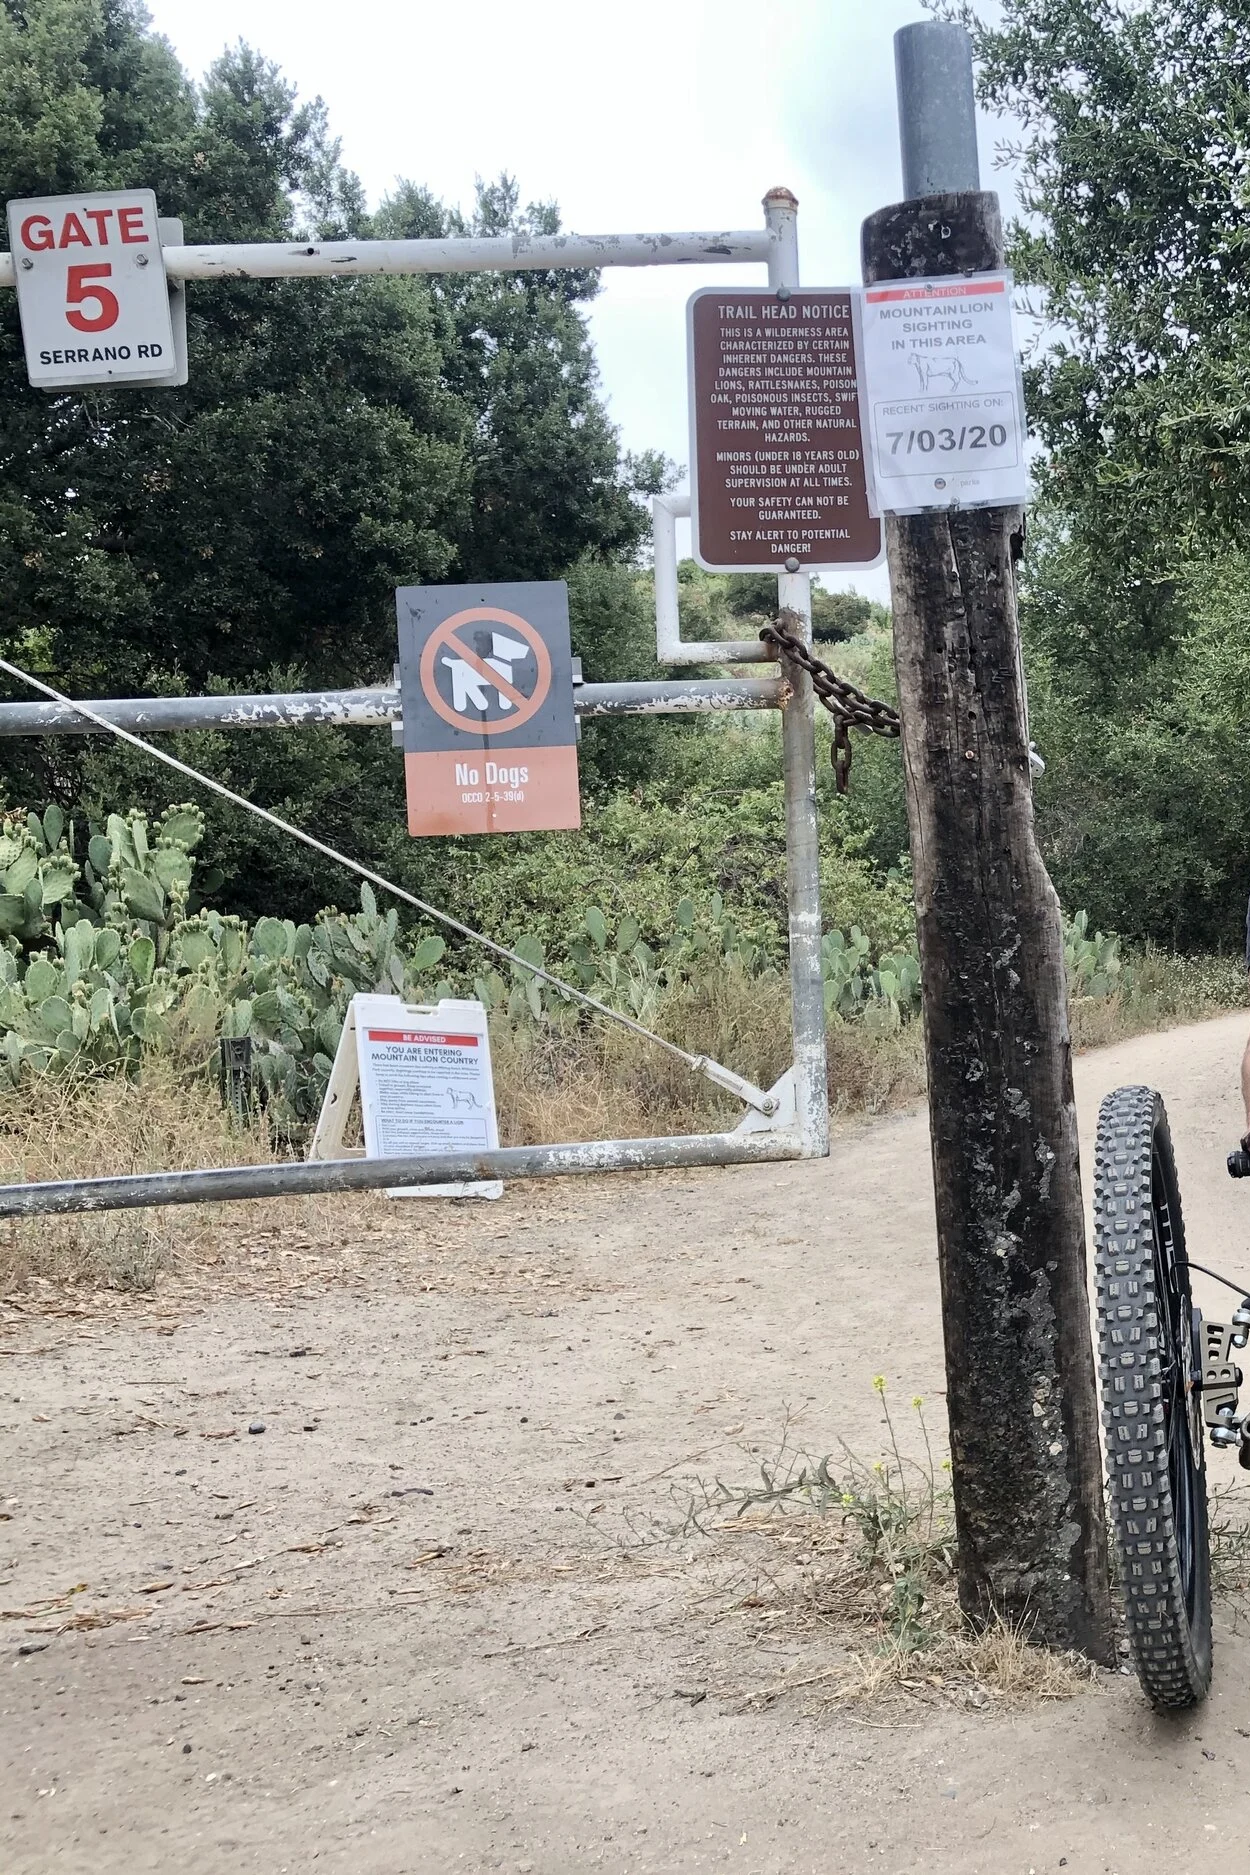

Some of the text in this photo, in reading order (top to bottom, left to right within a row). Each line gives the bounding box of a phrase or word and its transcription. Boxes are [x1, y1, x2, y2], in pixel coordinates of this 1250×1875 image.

[21, 207, 149, 251] GATE
[65, 263, 119, 332] 5
[903, 287, 966, 299] ATTENTION
[718, 305, 849, 319] TRAIL HEAD NOTICE
[880, 302, 993, 320] MOUNTAIN LION
[903, 319, 972, 332] SIGHTING
[720, 328, 848, 337] THIS IS A WILDERNESS AREA
[720, 341, 849, 350] CHARACTERIZED BY CERTAIN
[892, 334, 986, 350] IN THIS AREA
[40, 344, 162, 364] SERRANO RD
[723, 354, 847, 363] INHERENT DANGERS. THESE
[719, 367, 852, 376] DANGERS INCLUDE MOUNTAIN
[715, 379, 857, 391] LIONS, RATTLESNAKES, POISON
[711, 394, 732, 404] OAK,
[736, 394, 788, 403] POISONOUS
[791, 393, 832, 403] INSECTS,
[732, 406, 841, 417] MOVING WATER, RUGGED
[883, 399, 1003, 415] RECENT SIGHTING ON:
[717, 419, 857, 430] TERRAIN, AND OTHER NATURAL
[765, 433, 810, 442] HAZARDS.
[886, 424, 1006, 455] 7/03/20
[717, 450, 859, 461] MINORS (UNDER 18 YEARS OLD)
[730, 464, 847, 475] SHOULD BE UNDER ADULT
[725, 477, 852, 488] SUPERVISION AT ALL TIMES.
[730, 496, 848, 507] YOUR SAFETY CAN NOT BE
[759, 510, 821, 520] GUARANTEED.
[730, 529, 850, 540] STAY ALERT TO POTENTIAL
[771, 544, 811, 553] DANGER!
[456, 762, 529, 788] No Dogs
[414, 1035, 446, 1043] ADVISED
[407, 1047, 422, 1055] ARE
[424, 1048, 462, 1056] ENTERING
[372, 1054, 478, 1065] MOUNTAIN LION COUNTRY
